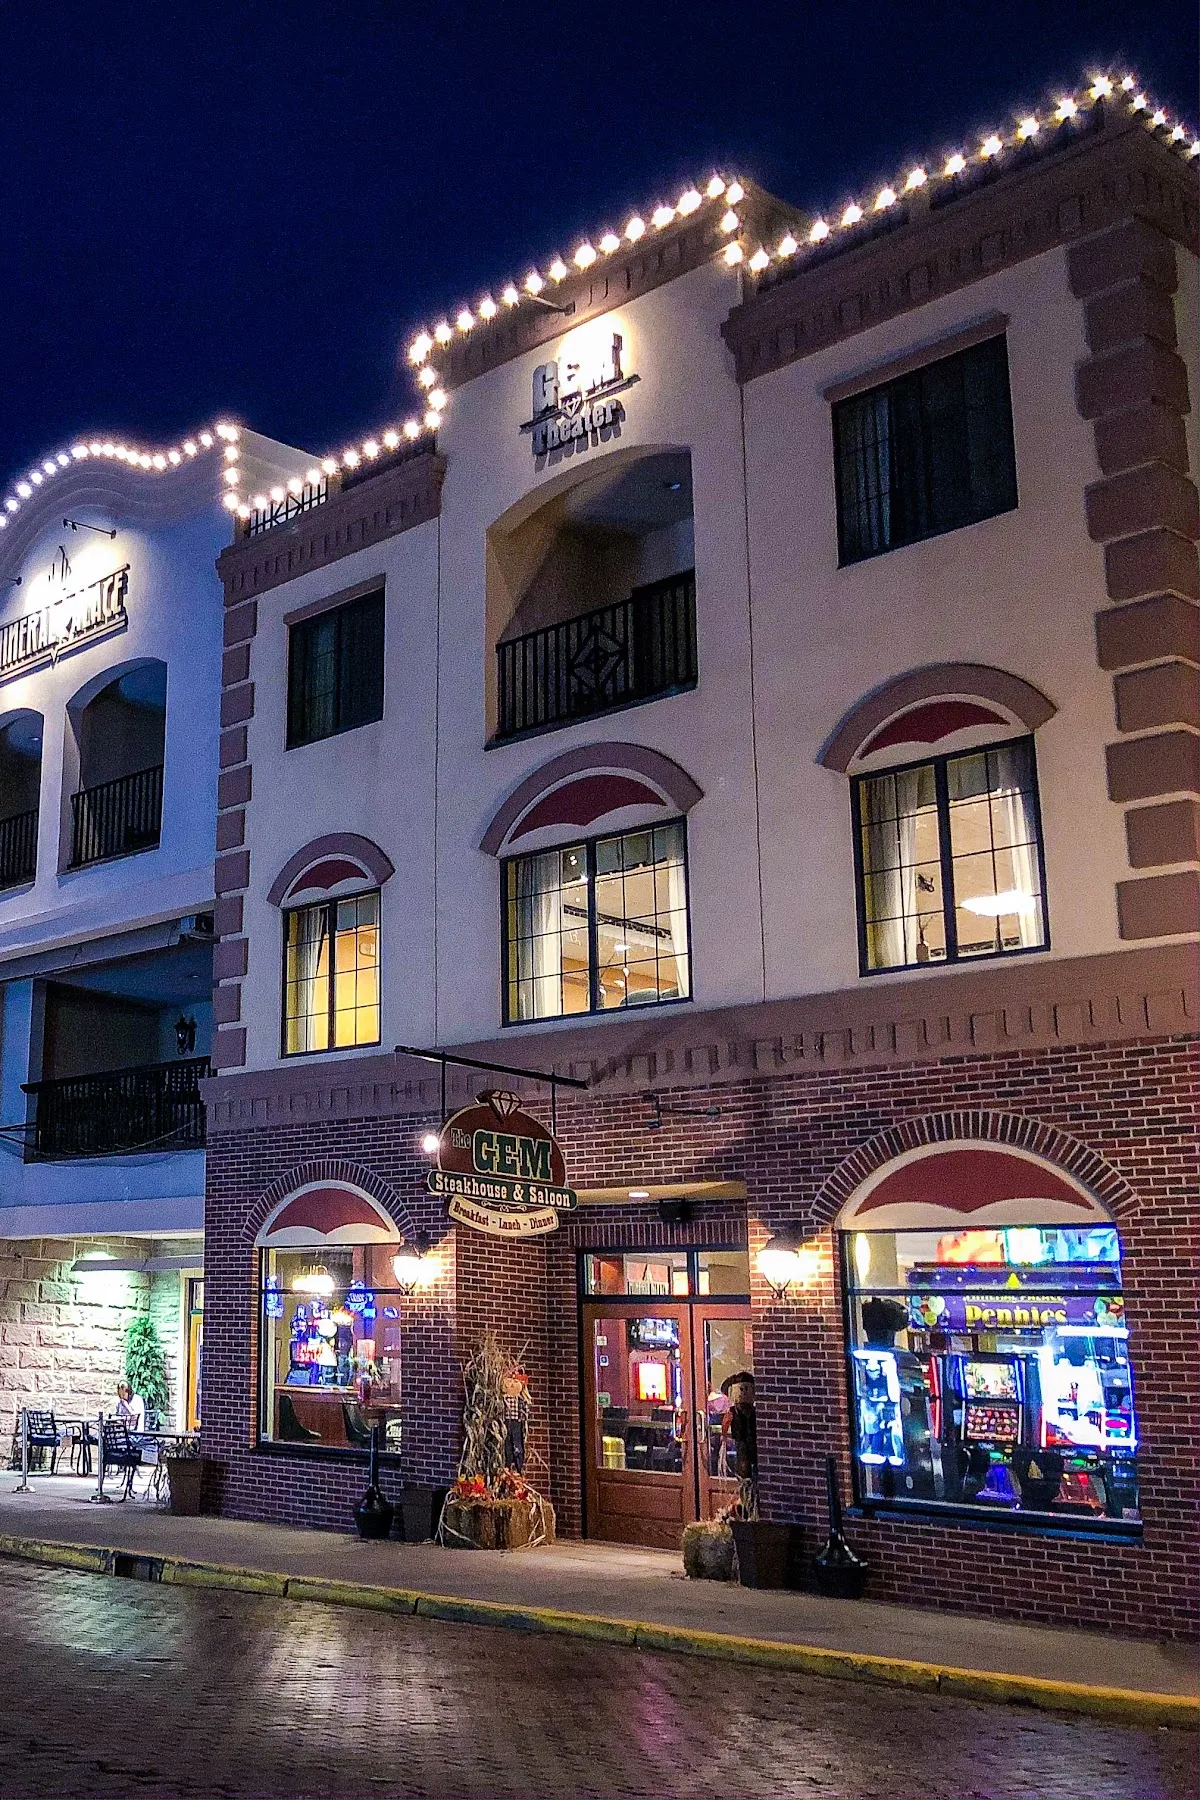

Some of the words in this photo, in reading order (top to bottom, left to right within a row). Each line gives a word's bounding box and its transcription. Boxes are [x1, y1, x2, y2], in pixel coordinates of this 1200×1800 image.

[532, 399, 626, 456] Theater
[451, 1127, 472, 1150] The
[472, 1129, 554, 1182] GEM
[435, 1173, 508, 1199] Steakhouse
[513, 1183, 525, 1202] &
[529, 1186, 571, 1208] Saloon
[453, 1201, 490, 1227] Breakfast
[499, 1217, 522, 1231] Lunch
[529, 1214, 555, 1230] Dinner
[965, 1304, 1068, 1329] Pennies
